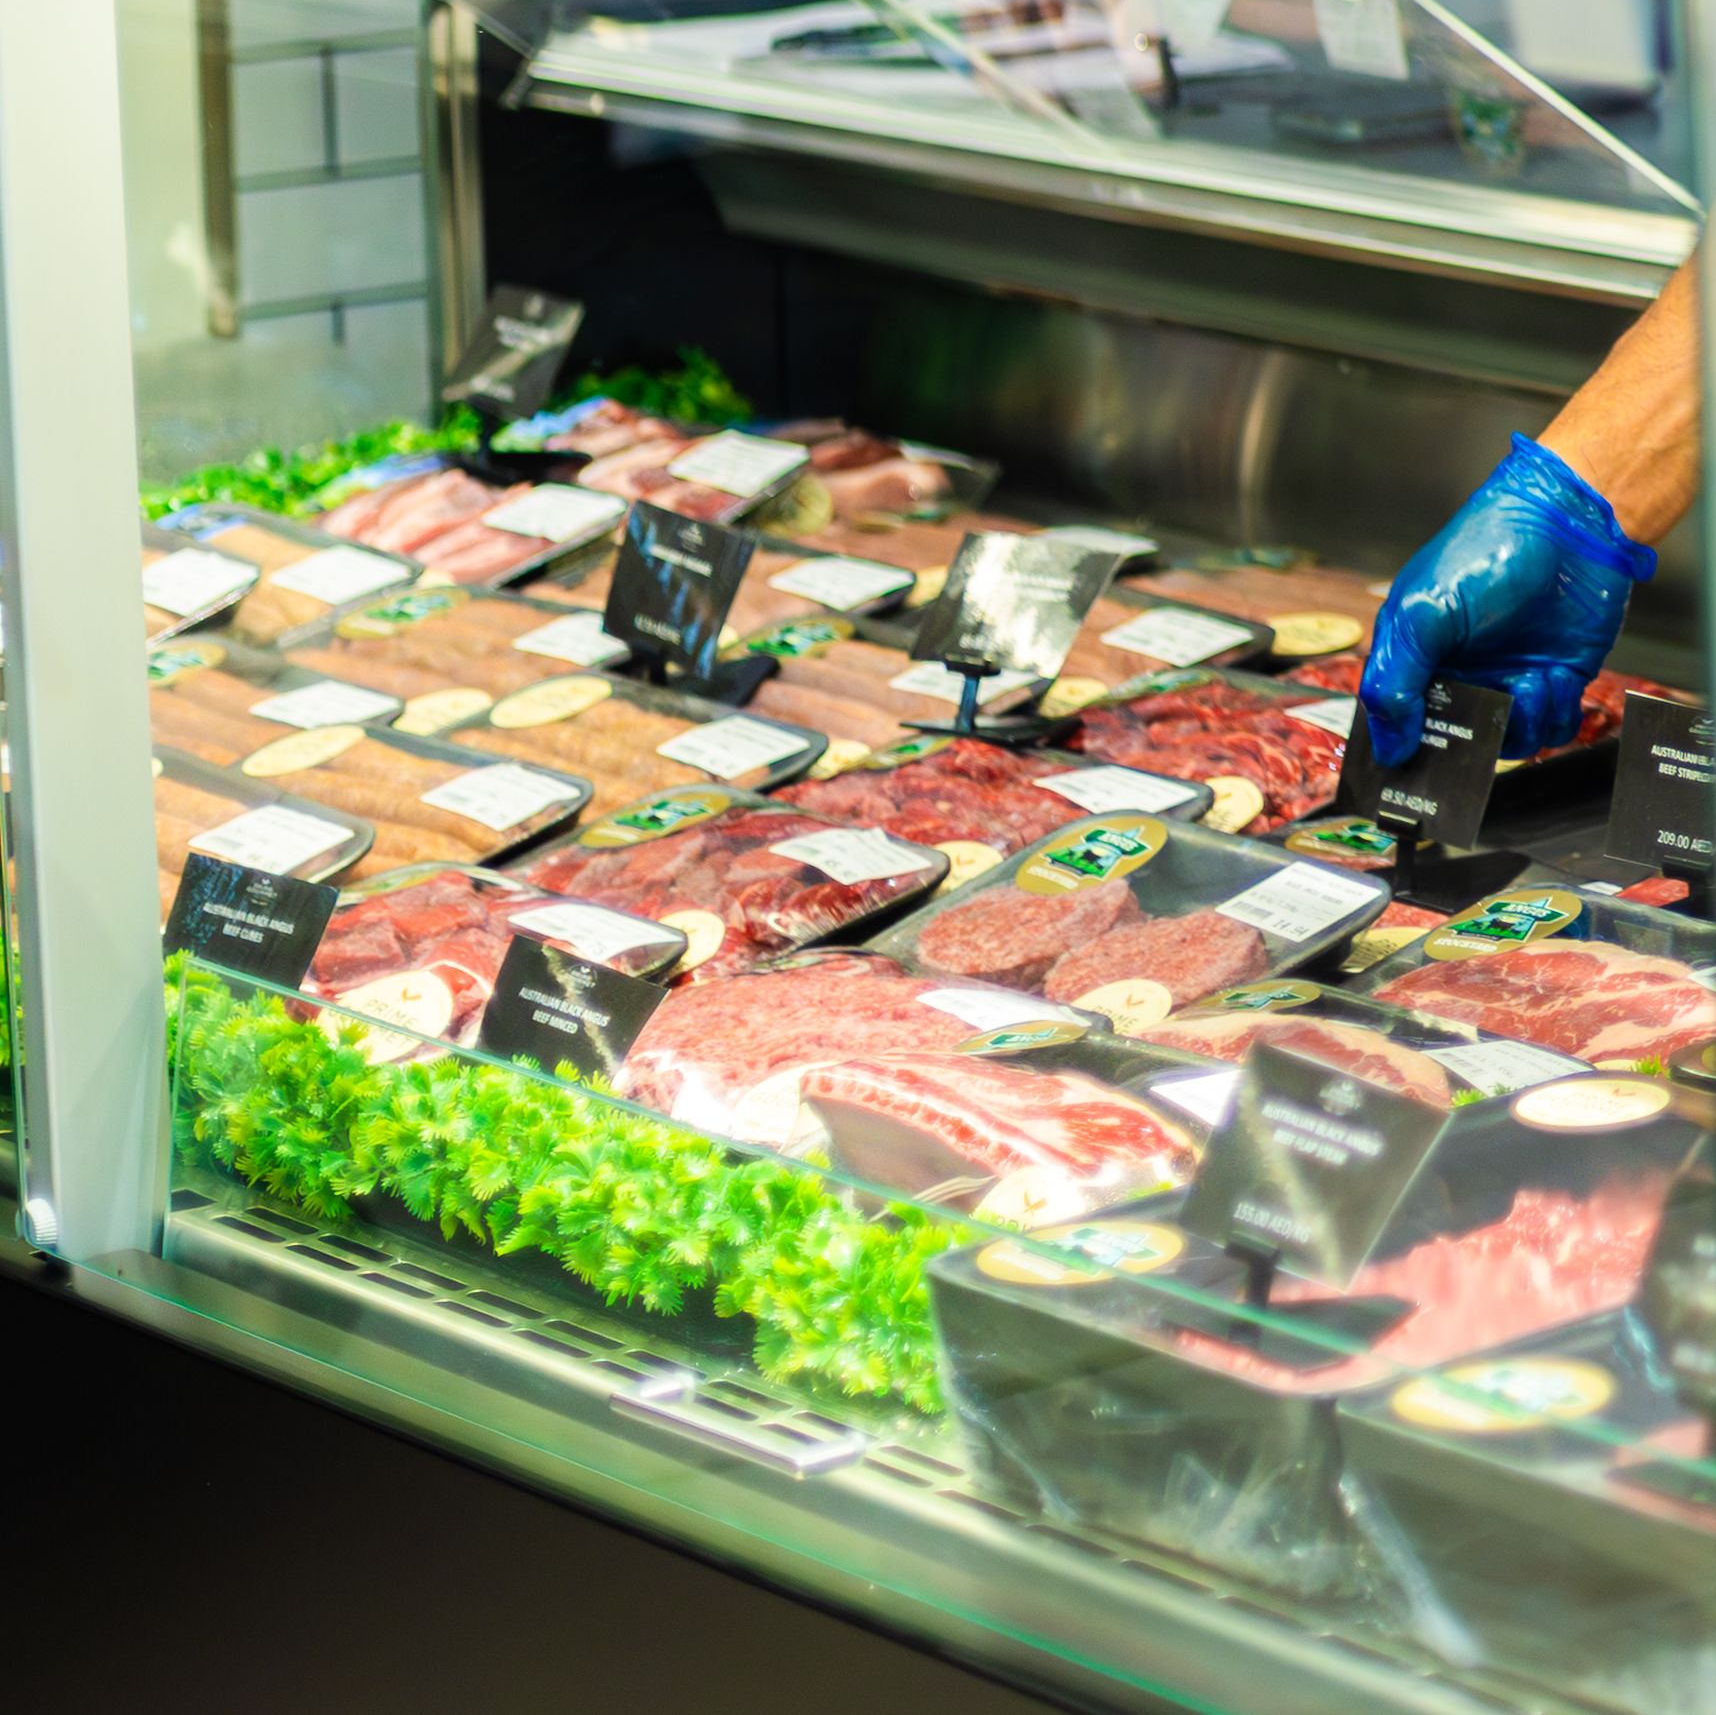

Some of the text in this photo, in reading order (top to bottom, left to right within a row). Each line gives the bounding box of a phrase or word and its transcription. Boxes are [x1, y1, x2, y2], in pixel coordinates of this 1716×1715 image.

[1651, 744, 1698, 765] AUSTRALIAN
[1658, 762, 1679, 776] BEEF
[1656, 830, 1691, 849] 209.00
[246, 911, 271, 928] BLACK
[269, 918, 296, 935] ANGUS
[519, 986, 612, 1028] AUSTRALIAN BLACK ANGUS
[532, 1009, 579, 1034] BEEF MINCED
[1261, 1102, 1317, 1133] AUSTRALIAN
[1233, 1201, 1272, 1229] 155.00
